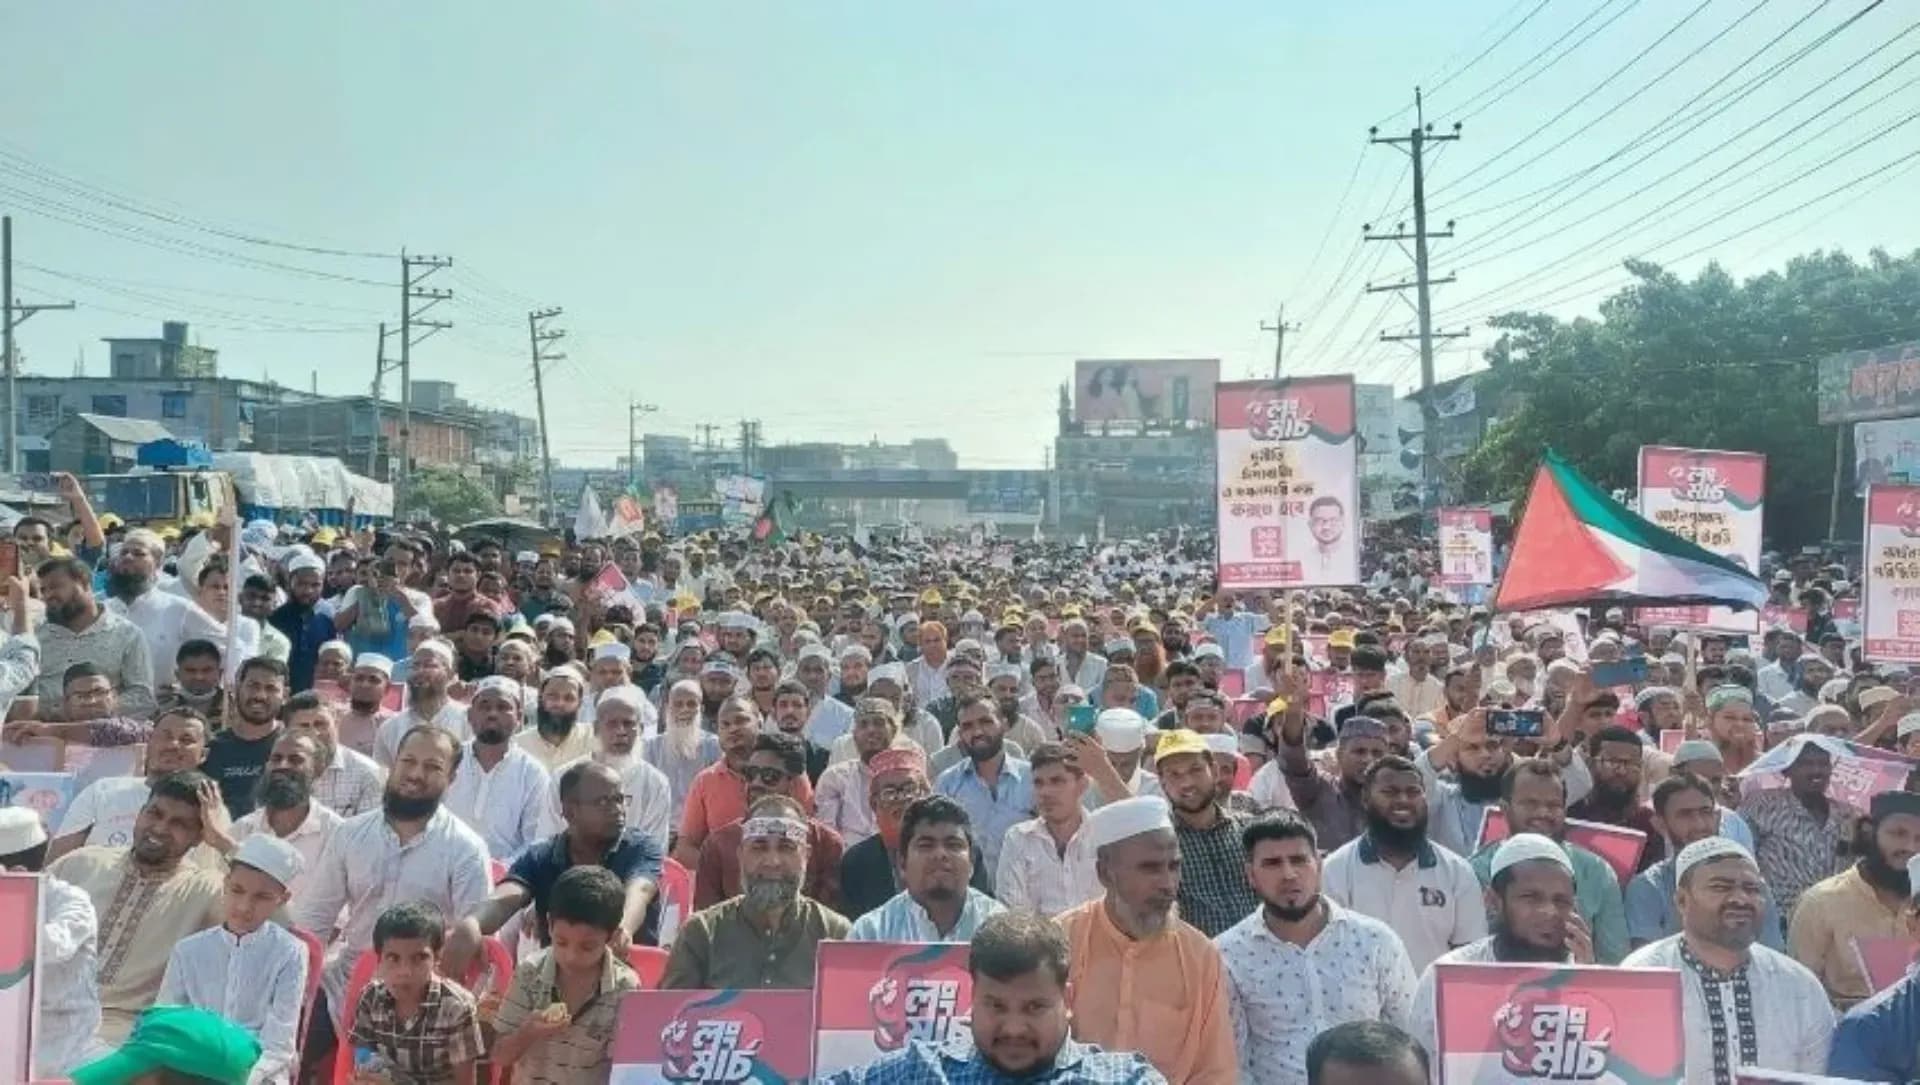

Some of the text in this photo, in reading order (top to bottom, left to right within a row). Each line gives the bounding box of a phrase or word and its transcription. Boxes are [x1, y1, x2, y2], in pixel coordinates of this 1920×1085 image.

[905, 979, 959, 1016] লং
[692, 1020, 743, 1050] লং
[1531, 1005, 1587, 1040] লং
[688, 1039, 760, 1081] মার্চ
[1531, 1027, 1611, 1077] মার্চ
